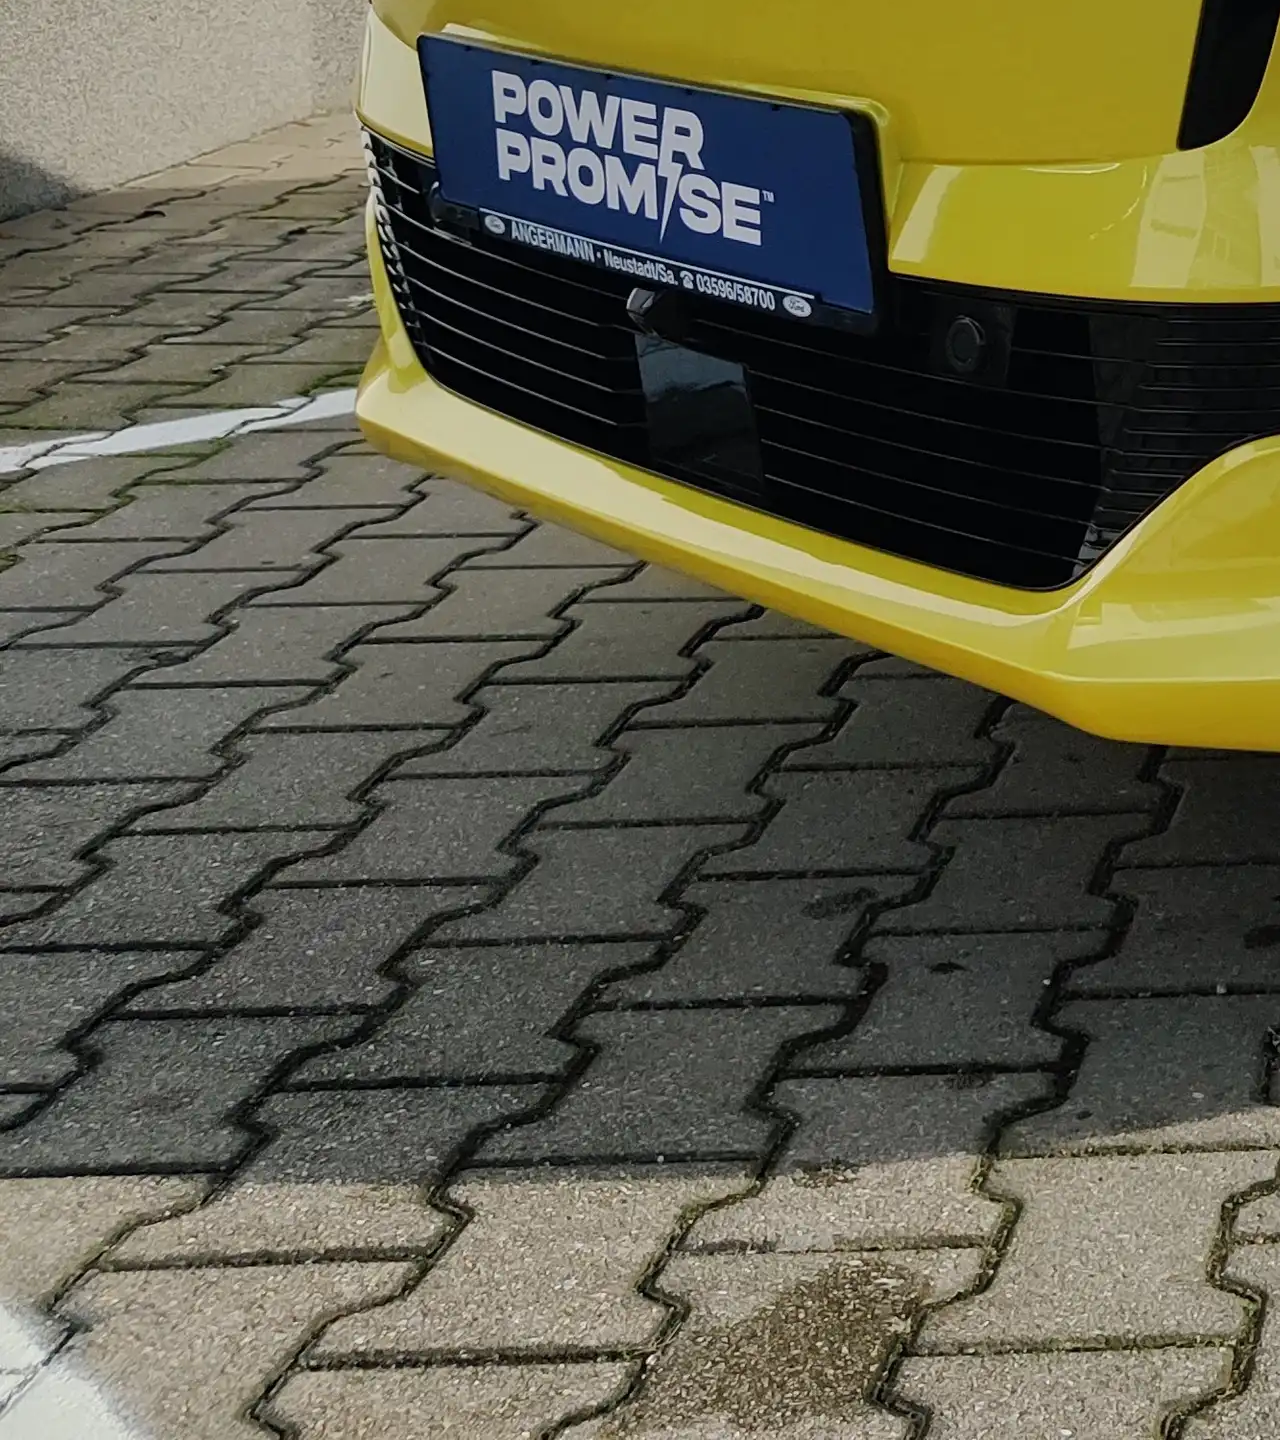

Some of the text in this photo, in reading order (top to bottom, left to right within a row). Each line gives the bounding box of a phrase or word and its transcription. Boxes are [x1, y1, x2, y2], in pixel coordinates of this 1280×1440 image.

[491, 69, 705, 171] POWER
[510, 219, 596, 263] ANGERMANN
[603, 249, 679, 287] Neustadt/Sa.
[695, 273, 776, 312] 03596/58700
